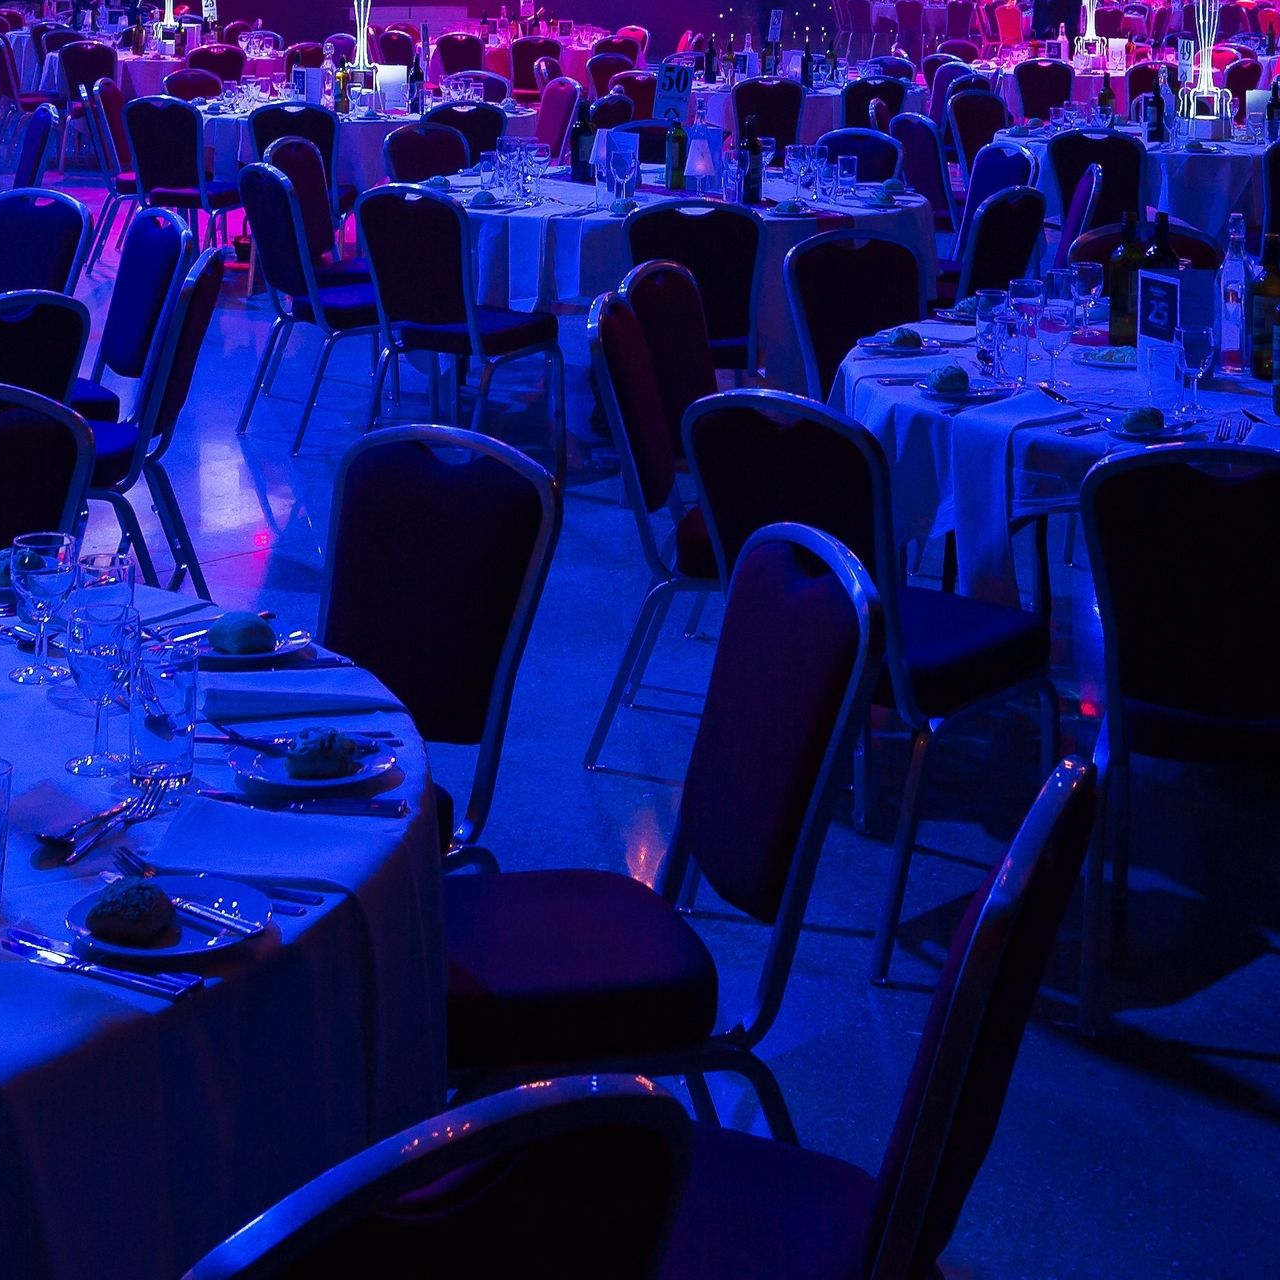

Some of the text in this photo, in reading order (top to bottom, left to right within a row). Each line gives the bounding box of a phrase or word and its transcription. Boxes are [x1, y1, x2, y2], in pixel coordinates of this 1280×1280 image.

[1179, 40, 1192, 62] 49
[661, 66, 689, 93] 50
[1147, 298, 1169, 321] 25
